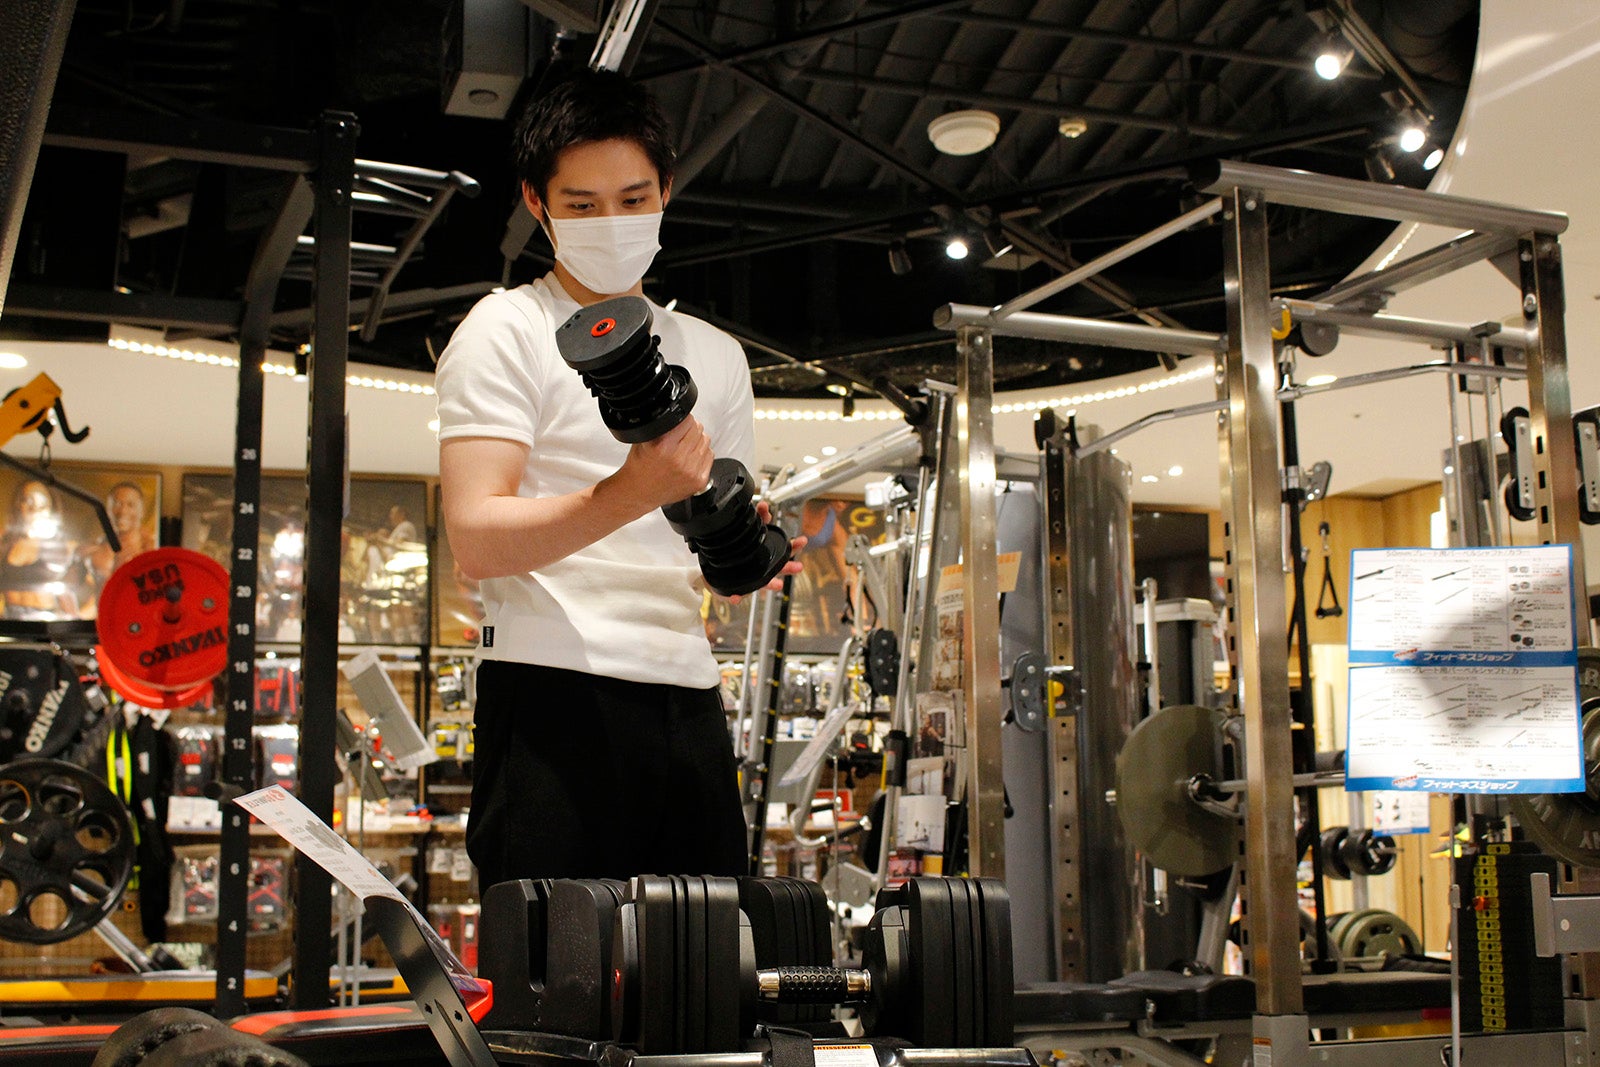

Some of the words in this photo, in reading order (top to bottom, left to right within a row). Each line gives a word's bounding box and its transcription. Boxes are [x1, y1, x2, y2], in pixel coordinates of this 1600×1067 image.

[239, 502, 254, 514] 24
[237, 547, 253, 560] 22
[130, 562, 182, 588] USA
[236, 585, 252, 598] 20
[235, 623, 250, 635] 18
[138, 626, 226, 668] IVANKO
[1423, 652, 1516, 663] フィットネスショップ
[234, 661, 249, 673] 16
[233, 699, 247, 711] 14
[232, 738, 246, 750] 12
[1423, 779, 1519, 791] フィットネスショップ
[232, 815, 241, 827] 8
[230, 862, 240, 875] 6
[228, 920, 238, 932] 4
[227, 977, 237, 990] 2
